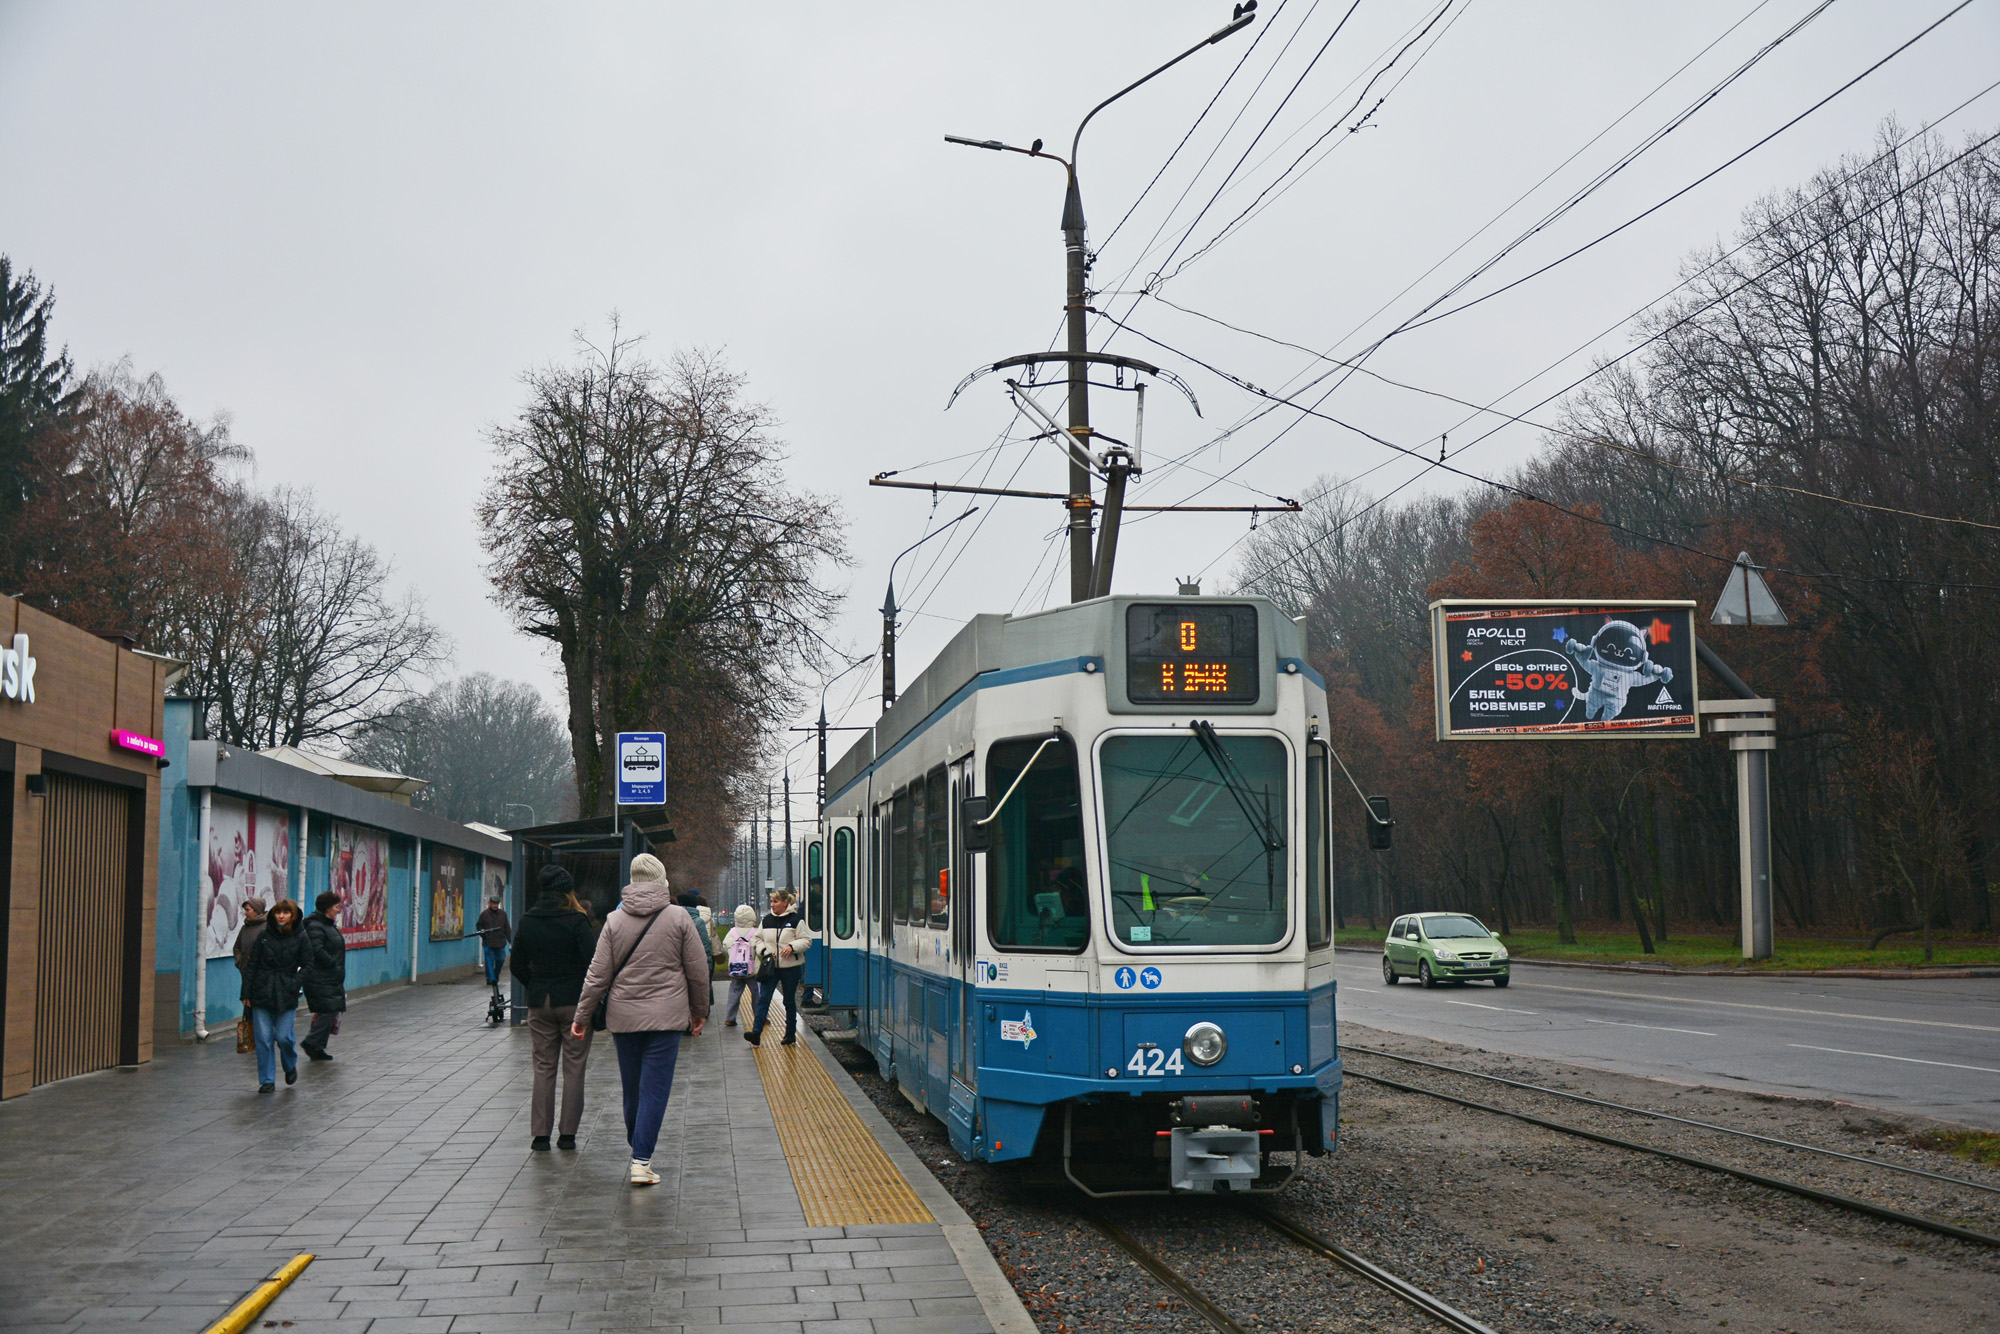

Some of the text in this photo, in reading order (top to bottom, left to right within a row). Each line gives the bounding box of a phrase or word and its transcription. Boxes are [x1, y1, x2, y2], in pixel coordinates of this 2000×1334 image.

[1466, 627, 1526, 638] APOLLO
[0, 633, 37, 704] sk
[1494, 663, 1568, 672] ВЕСЬ ФІТНЕС
[1495, 673, 1569, 690] -50%
[1469, 690, 1505, 699] БЛЕК
[1469, 701, 1546, 711] НОВЕМБЕР
[1127, 1048, 1185, 1075] 424
